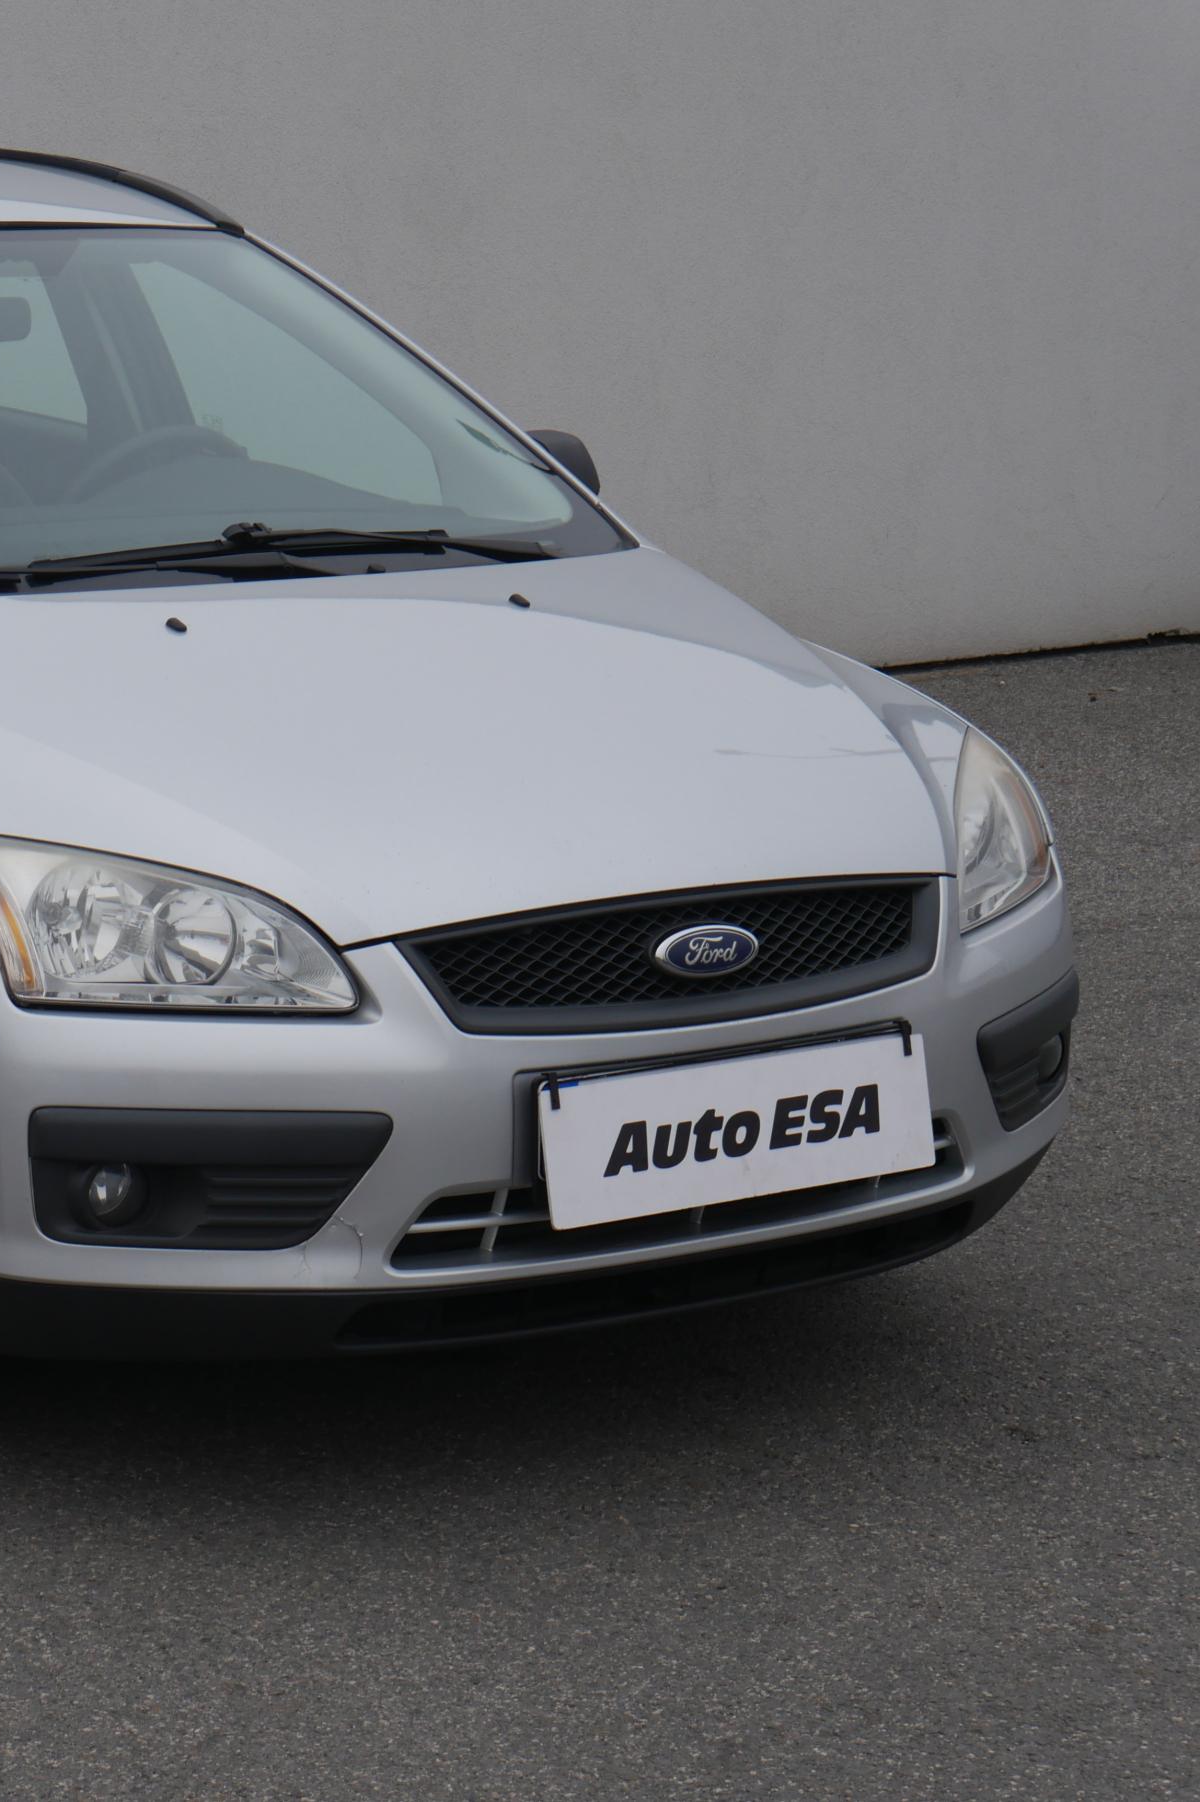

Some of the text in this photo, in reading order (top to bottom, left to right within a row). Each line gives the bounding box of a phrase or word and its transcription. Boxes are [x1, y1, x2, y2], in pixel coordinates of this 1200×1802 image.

[685, 935, 738, 966] Ford
[603, 1083, 881, 1178] Auto ESA
